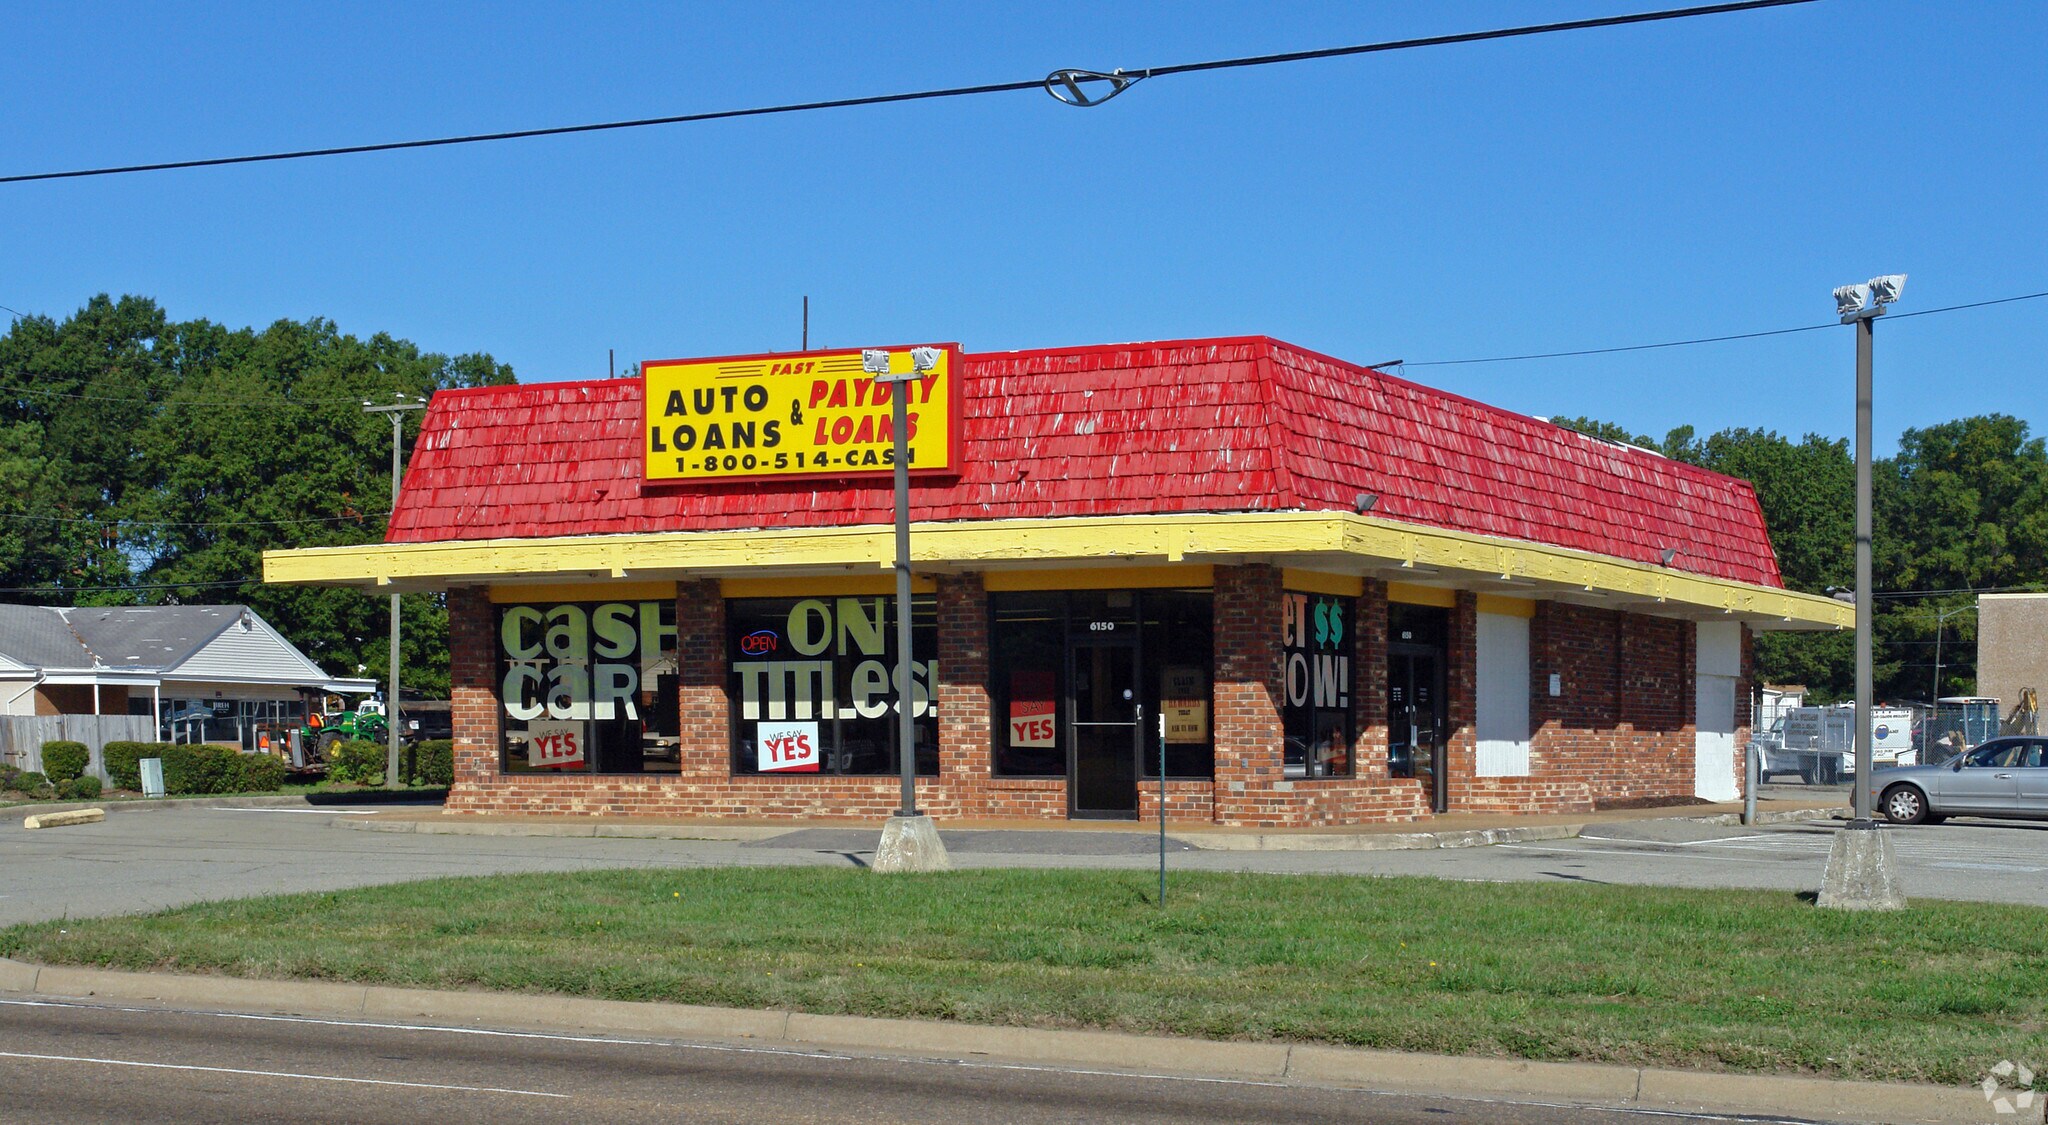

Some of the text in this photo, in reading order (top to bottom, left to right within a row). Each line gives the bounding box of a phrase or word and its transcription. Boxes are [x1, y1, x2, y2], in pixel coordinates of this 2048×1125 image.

[770, 362, 815, 376] FAST
[664, 385, 769, 417] AUTO
[790, 399, 804, 426] &
[652, 420, 782, 453] LOANS
[787, 598, 885, 656] ON
[1089, 622, 1115, 631] 6150
[741, 635, 778, 651] OPEN
[1283, 652, 1348, 708] OW!
[1021, 700, 1045, 714] SAY
[769, 729, 803, 742] WE SAY
[1012, 719, 1054, 742] YES
[533, 733, 577, 759] YES
[764, 735, 811, 762] YES
